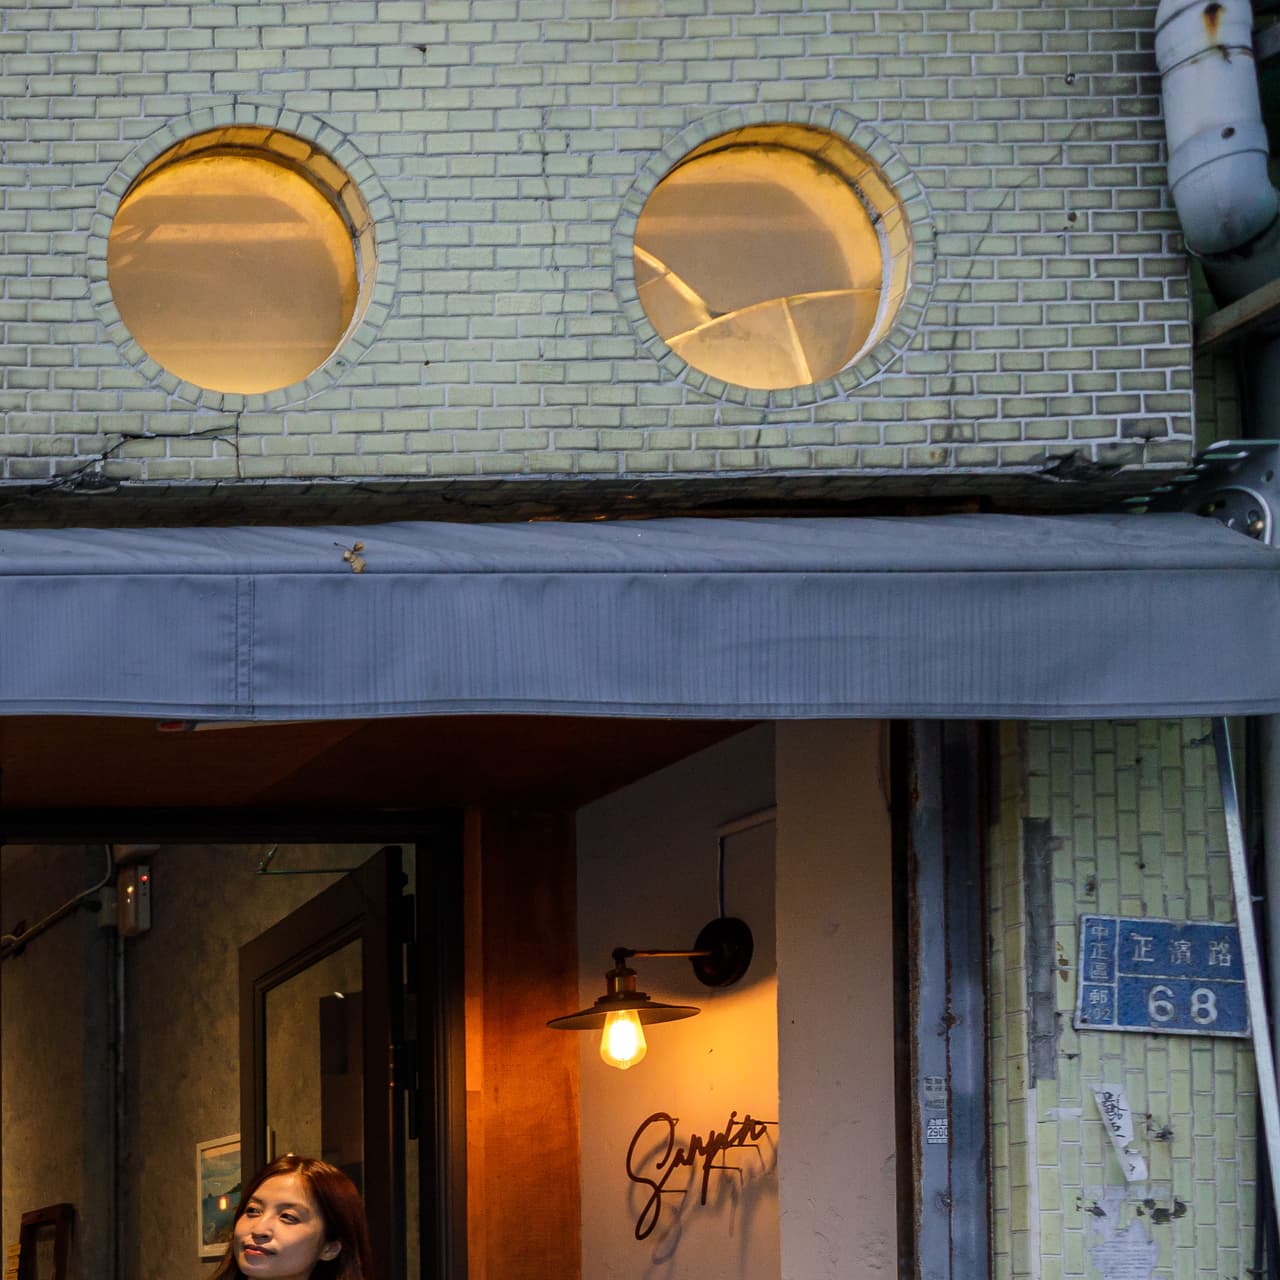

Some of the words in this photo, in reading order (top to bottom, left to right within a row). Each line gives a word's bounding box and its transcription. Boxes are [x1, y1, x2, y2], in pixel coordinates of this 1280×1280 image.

[1089, 925, 1109, 979] 中正區
[1129, 931, 1233, 967] 正濱路
[1088, 988, 1109, 1005] 郵
[1148, 984, 1218, 1025] 68
